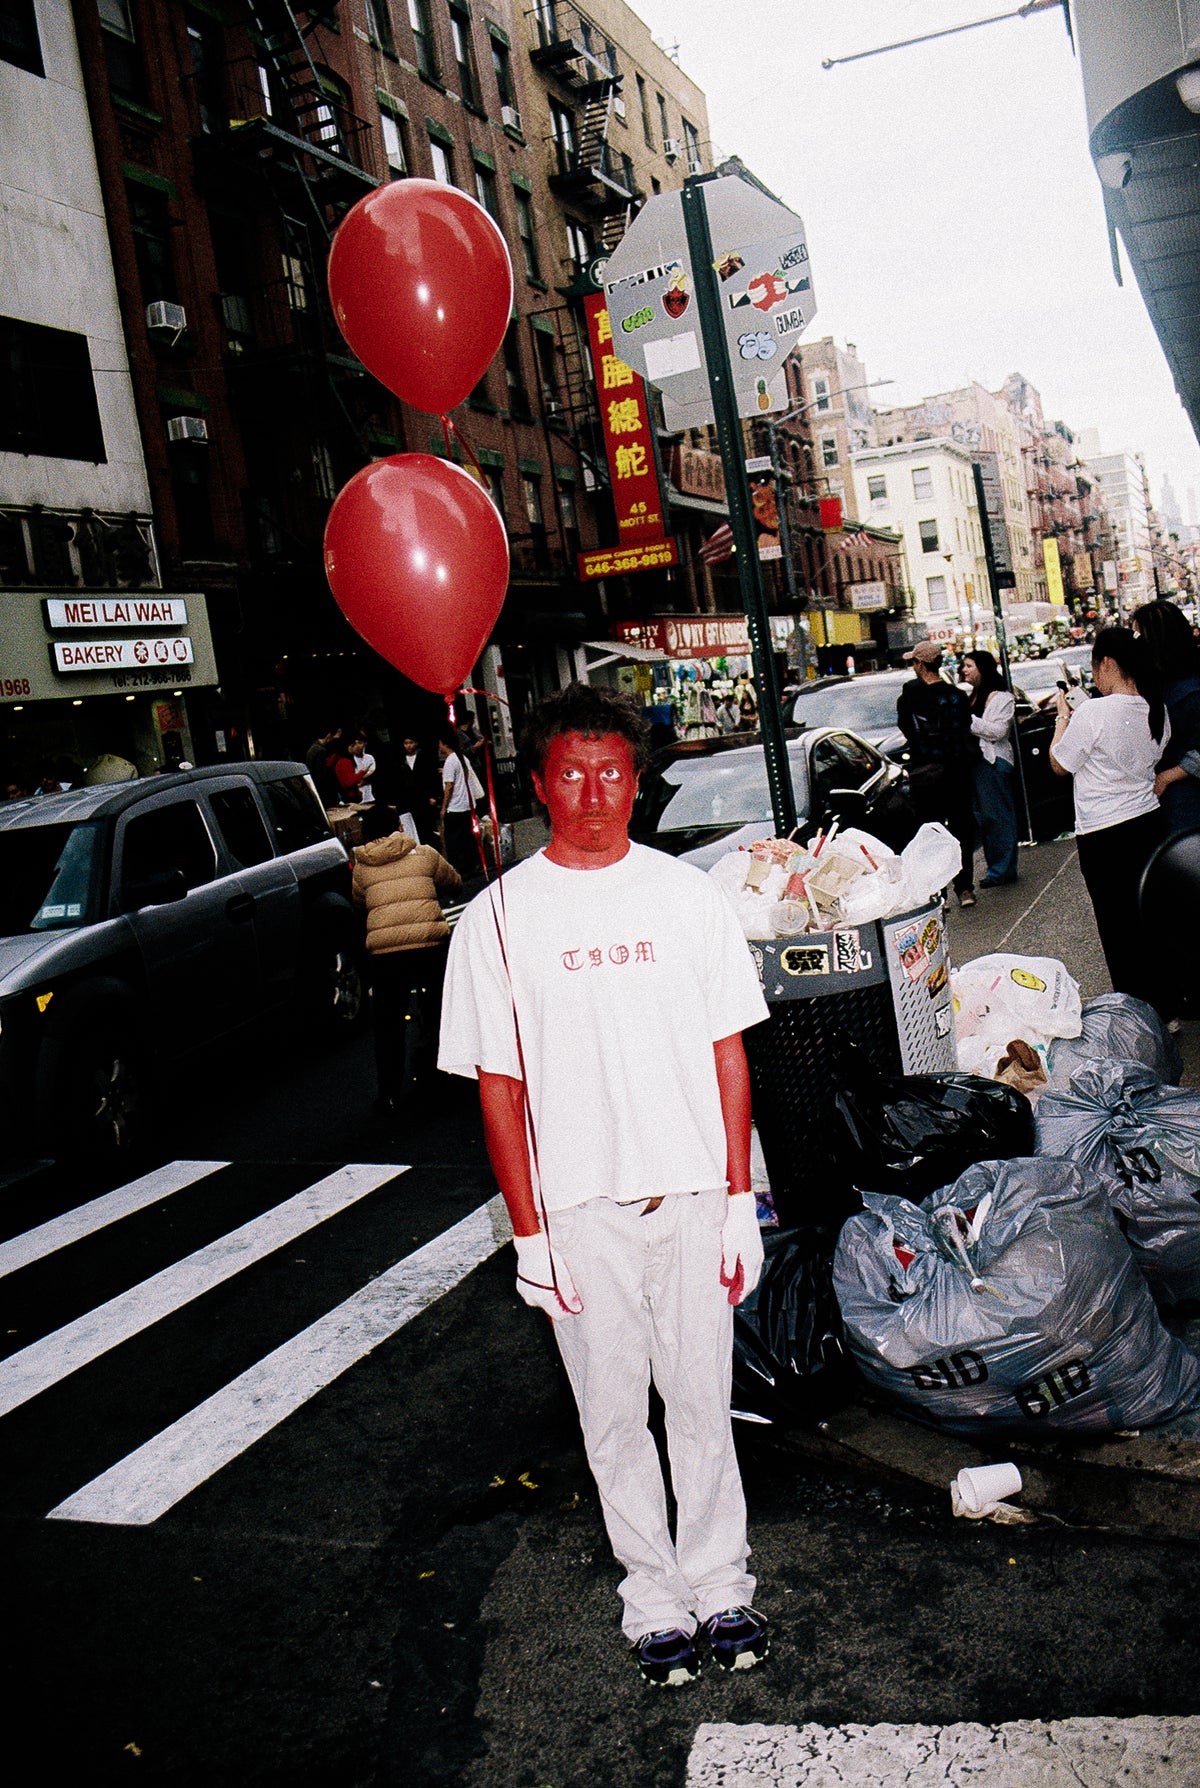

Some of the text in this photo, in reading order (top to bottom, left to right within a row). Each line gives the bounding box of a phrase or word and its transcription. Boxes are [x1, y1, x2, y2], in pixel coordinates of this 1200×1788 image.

[630, 502, 647, 513] 45
[619, 516, 646, 527] MOTT
[64, 602, 173, 623] MEI LAI WAH
[62, 645, 123, 665] BAKERY
[0, 678, 31, 697] 1968
[911, 1350, 989, 1391] BID
